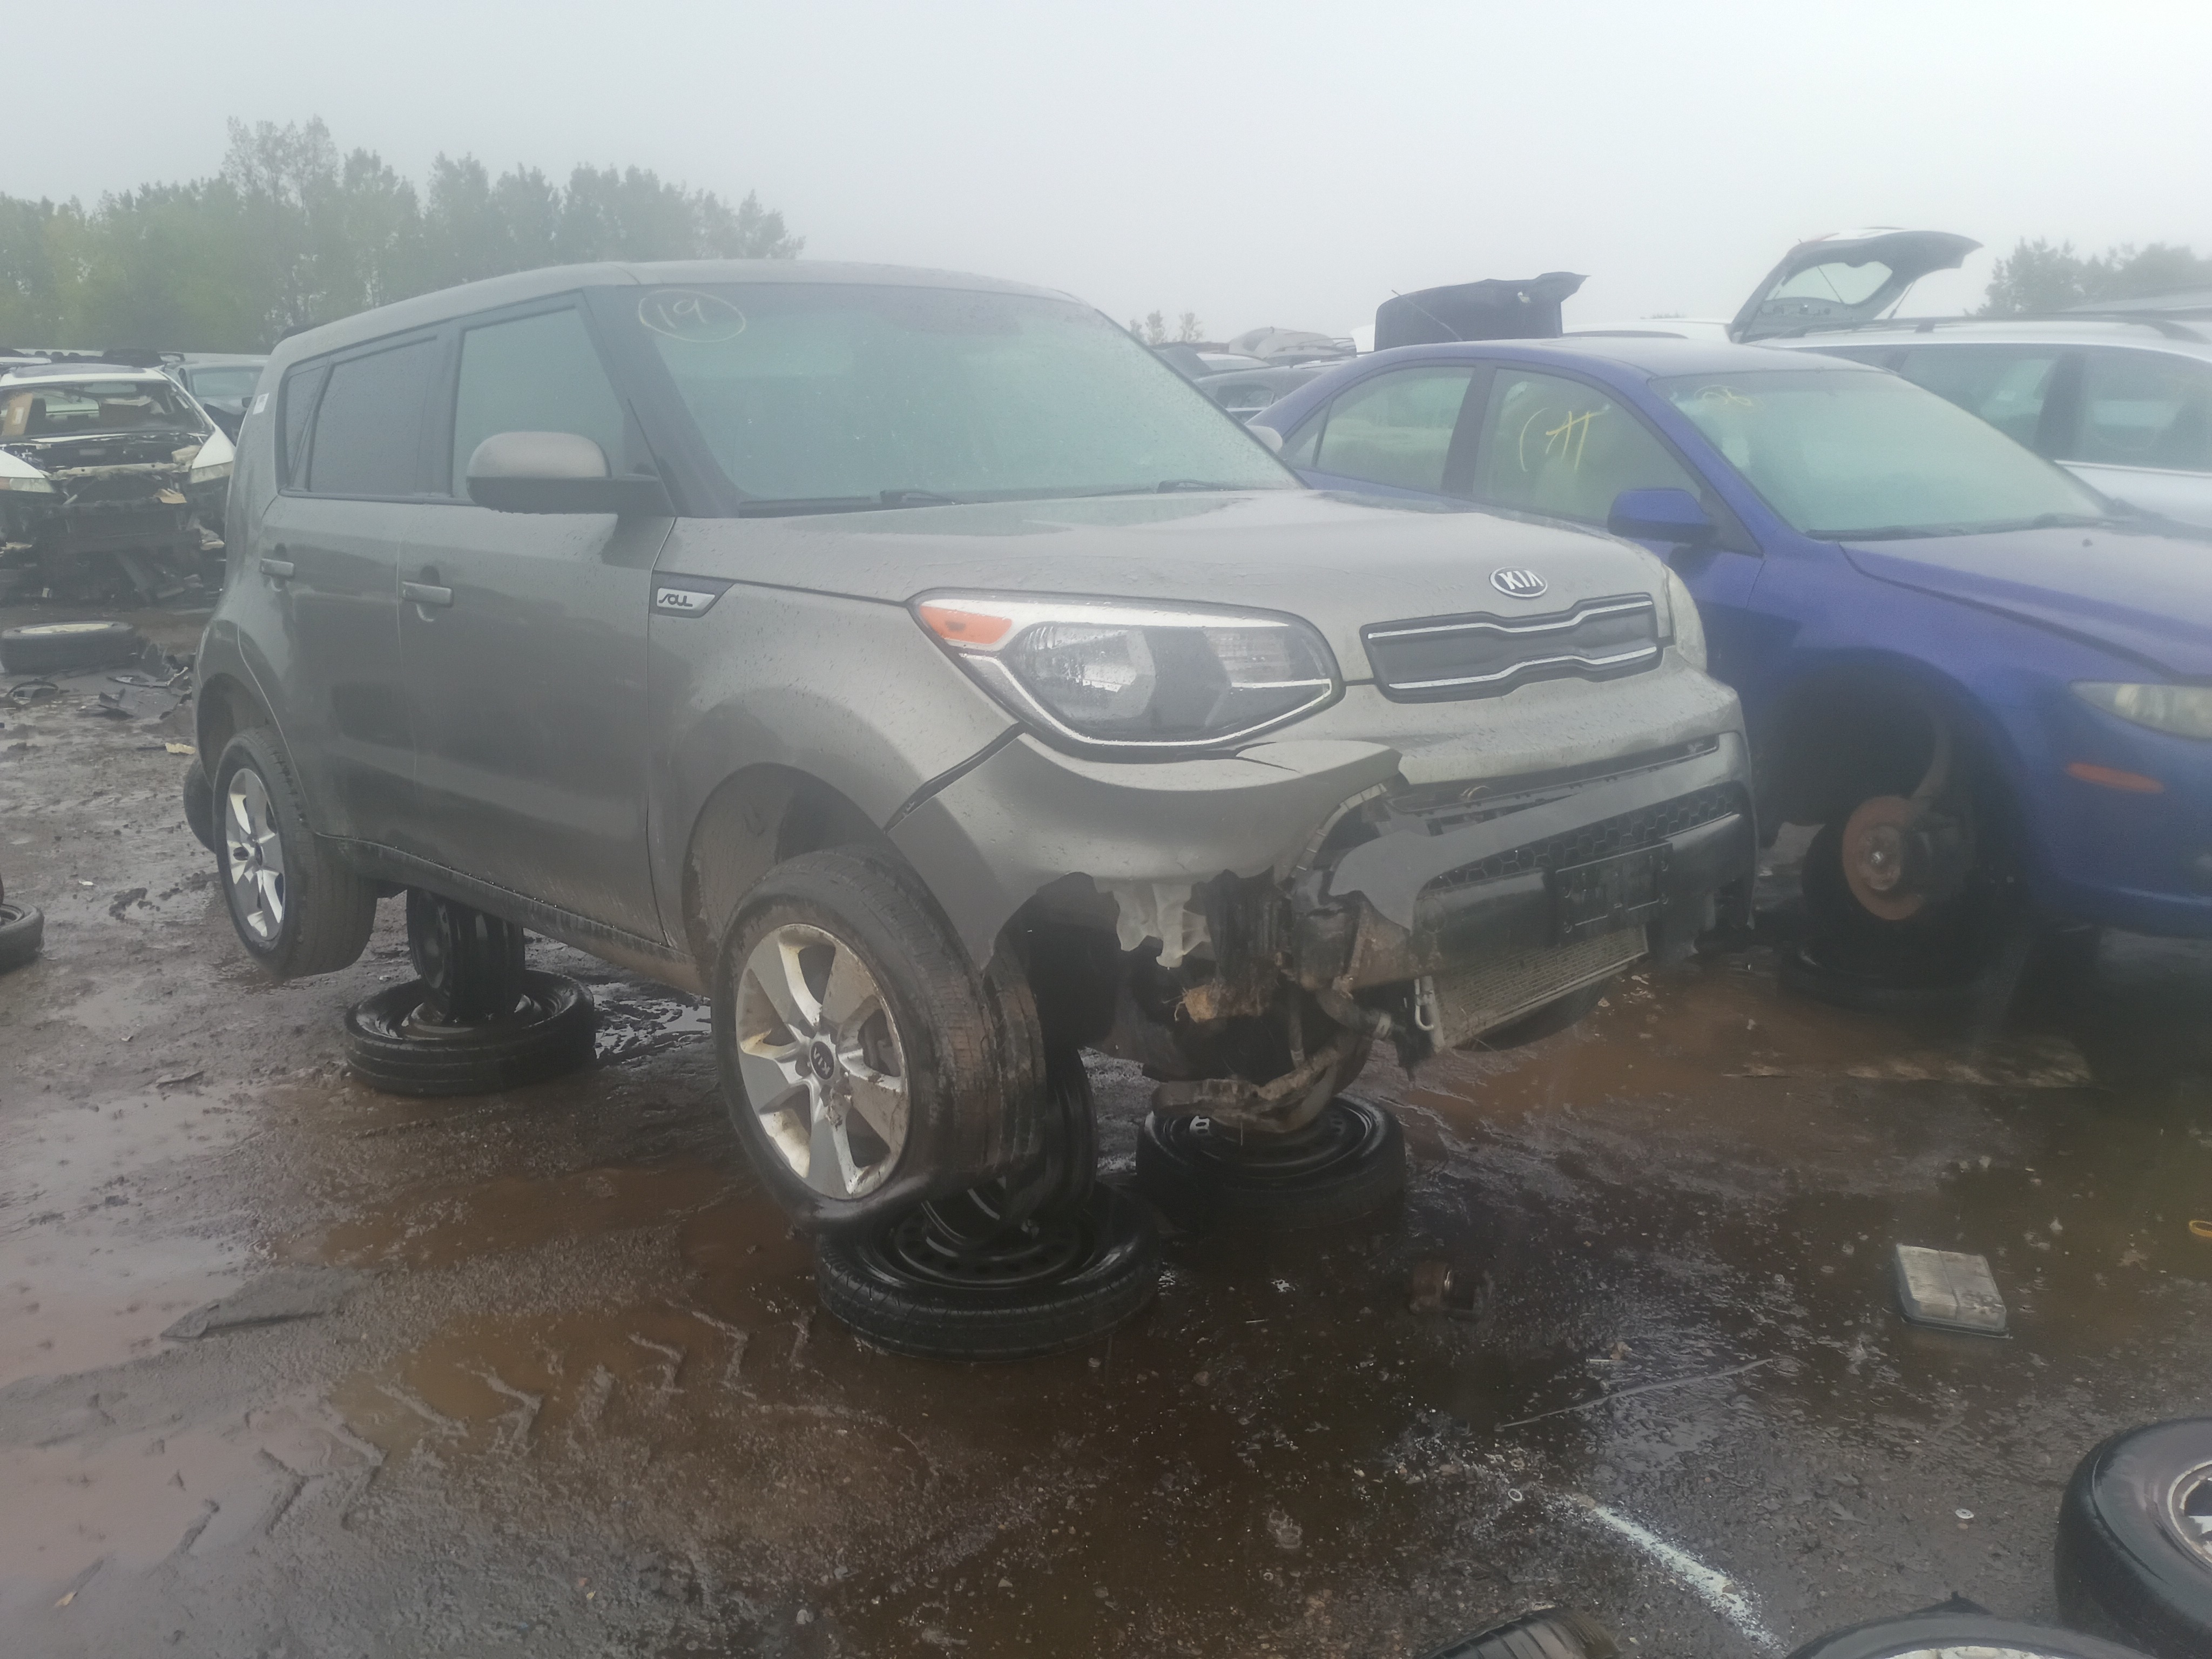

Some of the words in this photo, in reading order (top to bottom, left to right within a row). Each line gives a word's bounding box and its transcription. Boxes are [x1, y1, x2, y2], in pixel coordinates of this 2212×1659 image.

[1498, 570, 1544, 590] KIA
[658, 594, 693, 607] SOUL
[813, 1047, 831, 1075] KIA
